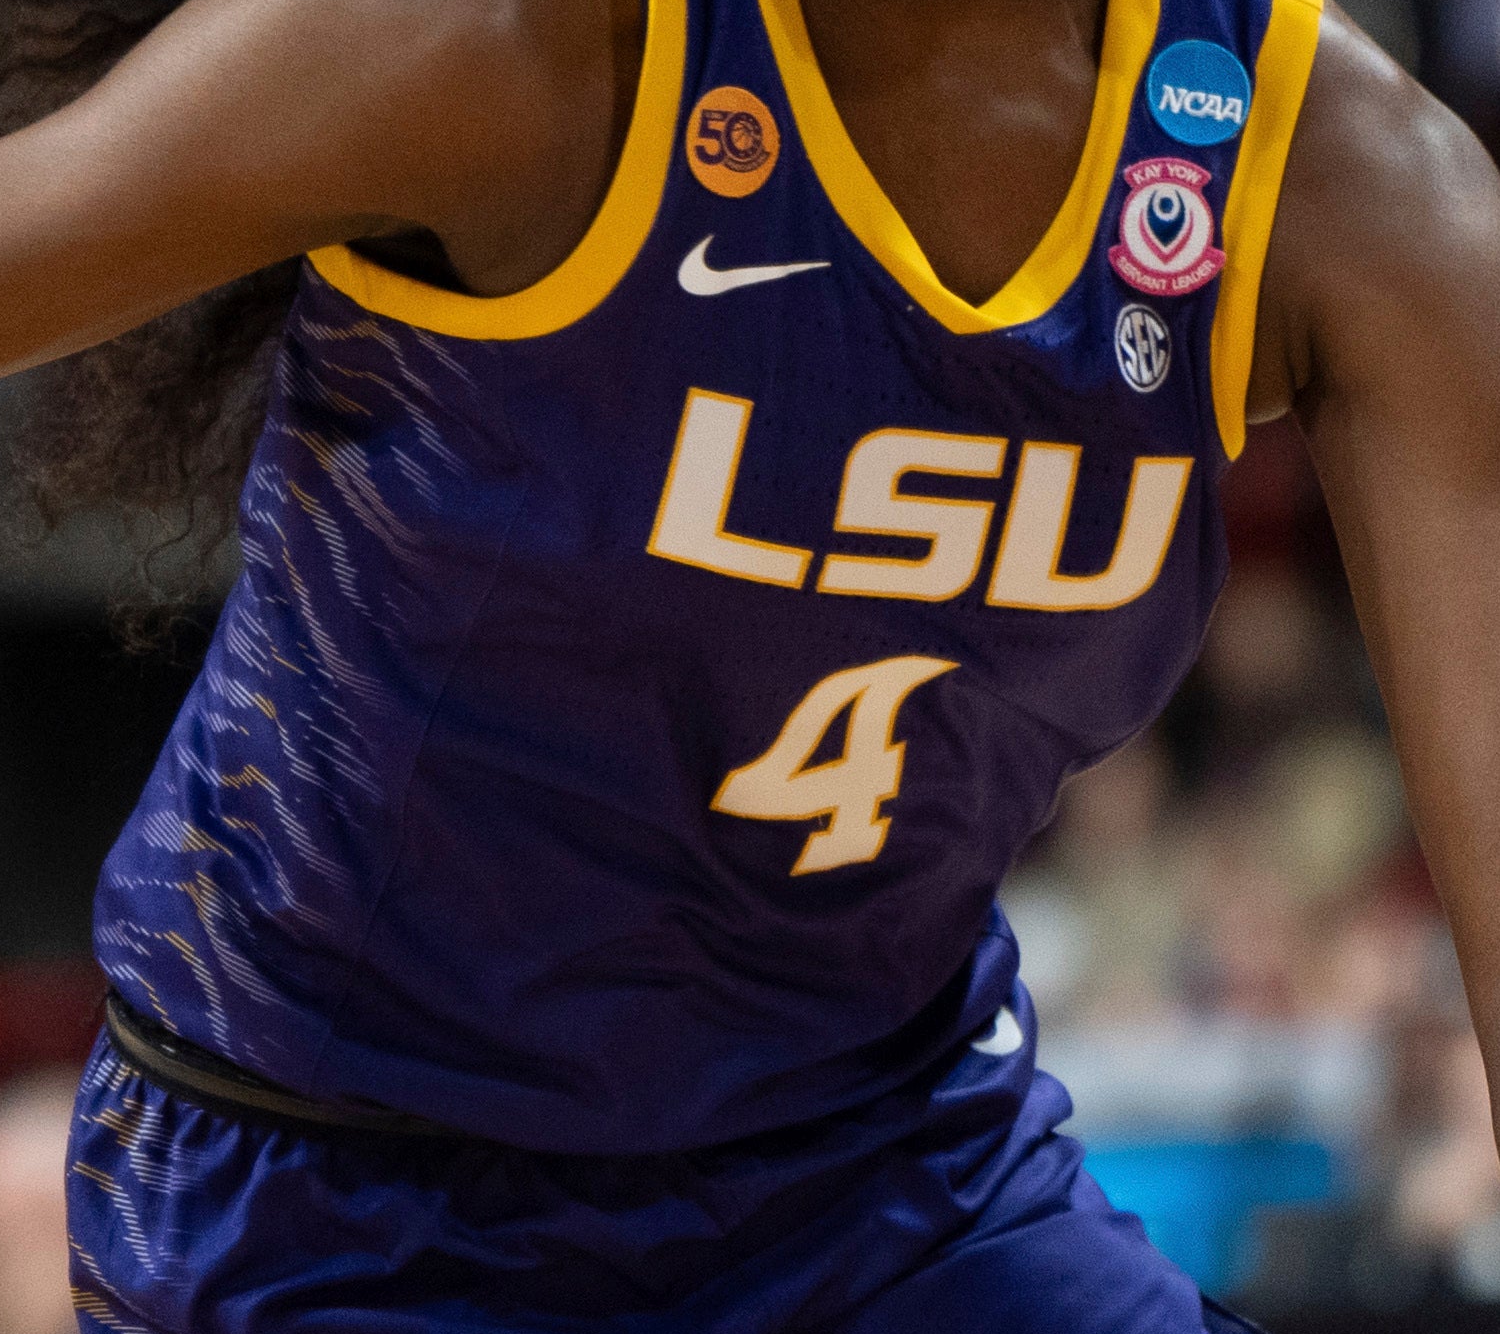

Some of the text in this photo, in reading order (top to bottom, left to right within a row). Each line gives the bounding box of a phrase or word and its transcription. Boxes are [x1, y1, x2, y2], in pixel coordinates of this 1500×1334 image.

[1158, 83, 1243, 125] NCAA
[1131, 162, 1201, 185] KAY YOW
[1115, 255, 1216, 291] SERVANT LEADER
[1119, 311, 1166, 385] SEC
[646, 386, 1195, 612] LSU
[709, 654, 962, 876] 4
